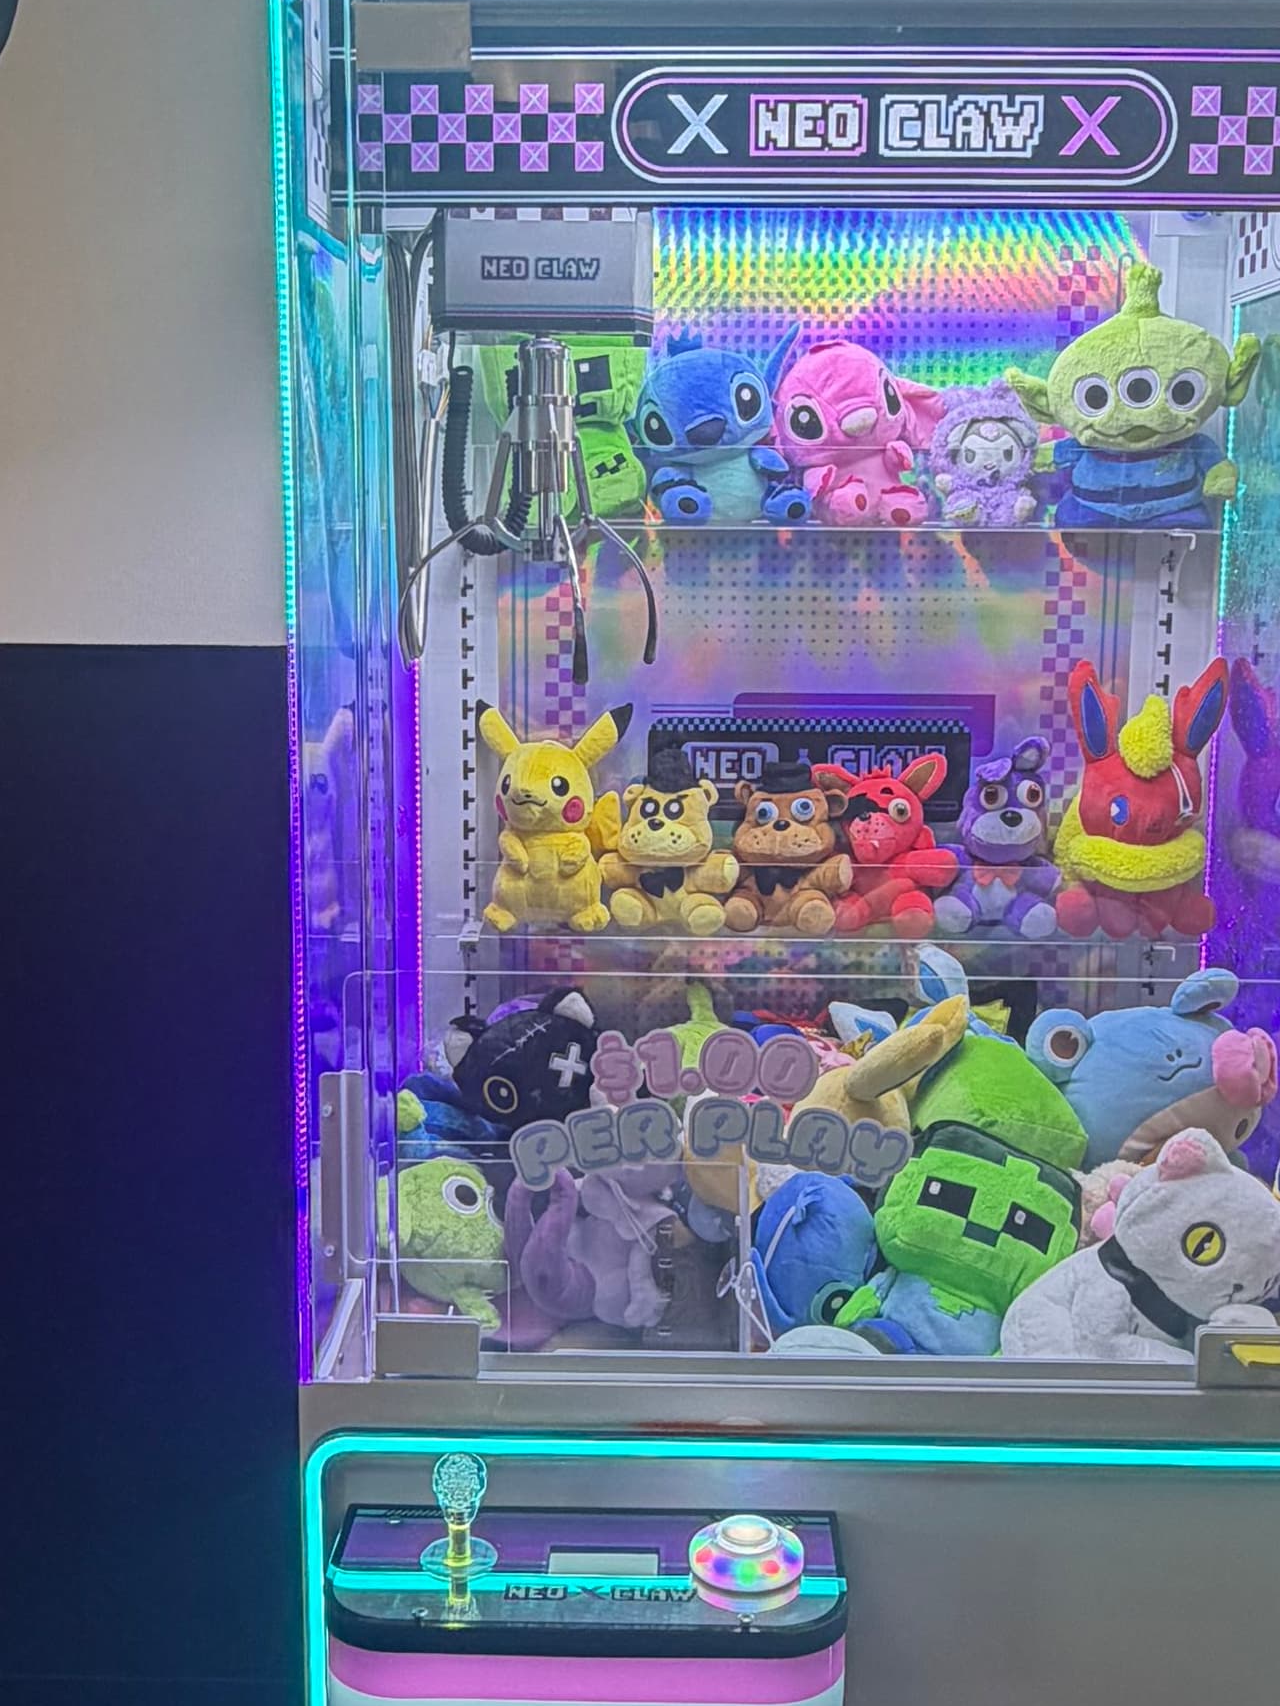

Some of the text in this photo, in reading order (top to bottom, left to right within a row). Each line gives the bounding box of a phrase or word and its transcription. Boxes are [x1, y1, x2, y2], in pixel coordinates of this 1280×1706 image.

[756, 101, 861, 150] NEO
[886, 102, 1037, 151] CLAW
[483, 258, 598, 278] NEO CLAW
[694, 750, 763, 780] NEO
[592, 1030, 817, 1105] $1.00
[513, 1099, 908, 1187] PER PLAY
[507, 1584, 565, 1599] NEO
[613, 1586, 695, 1601] CLAW
